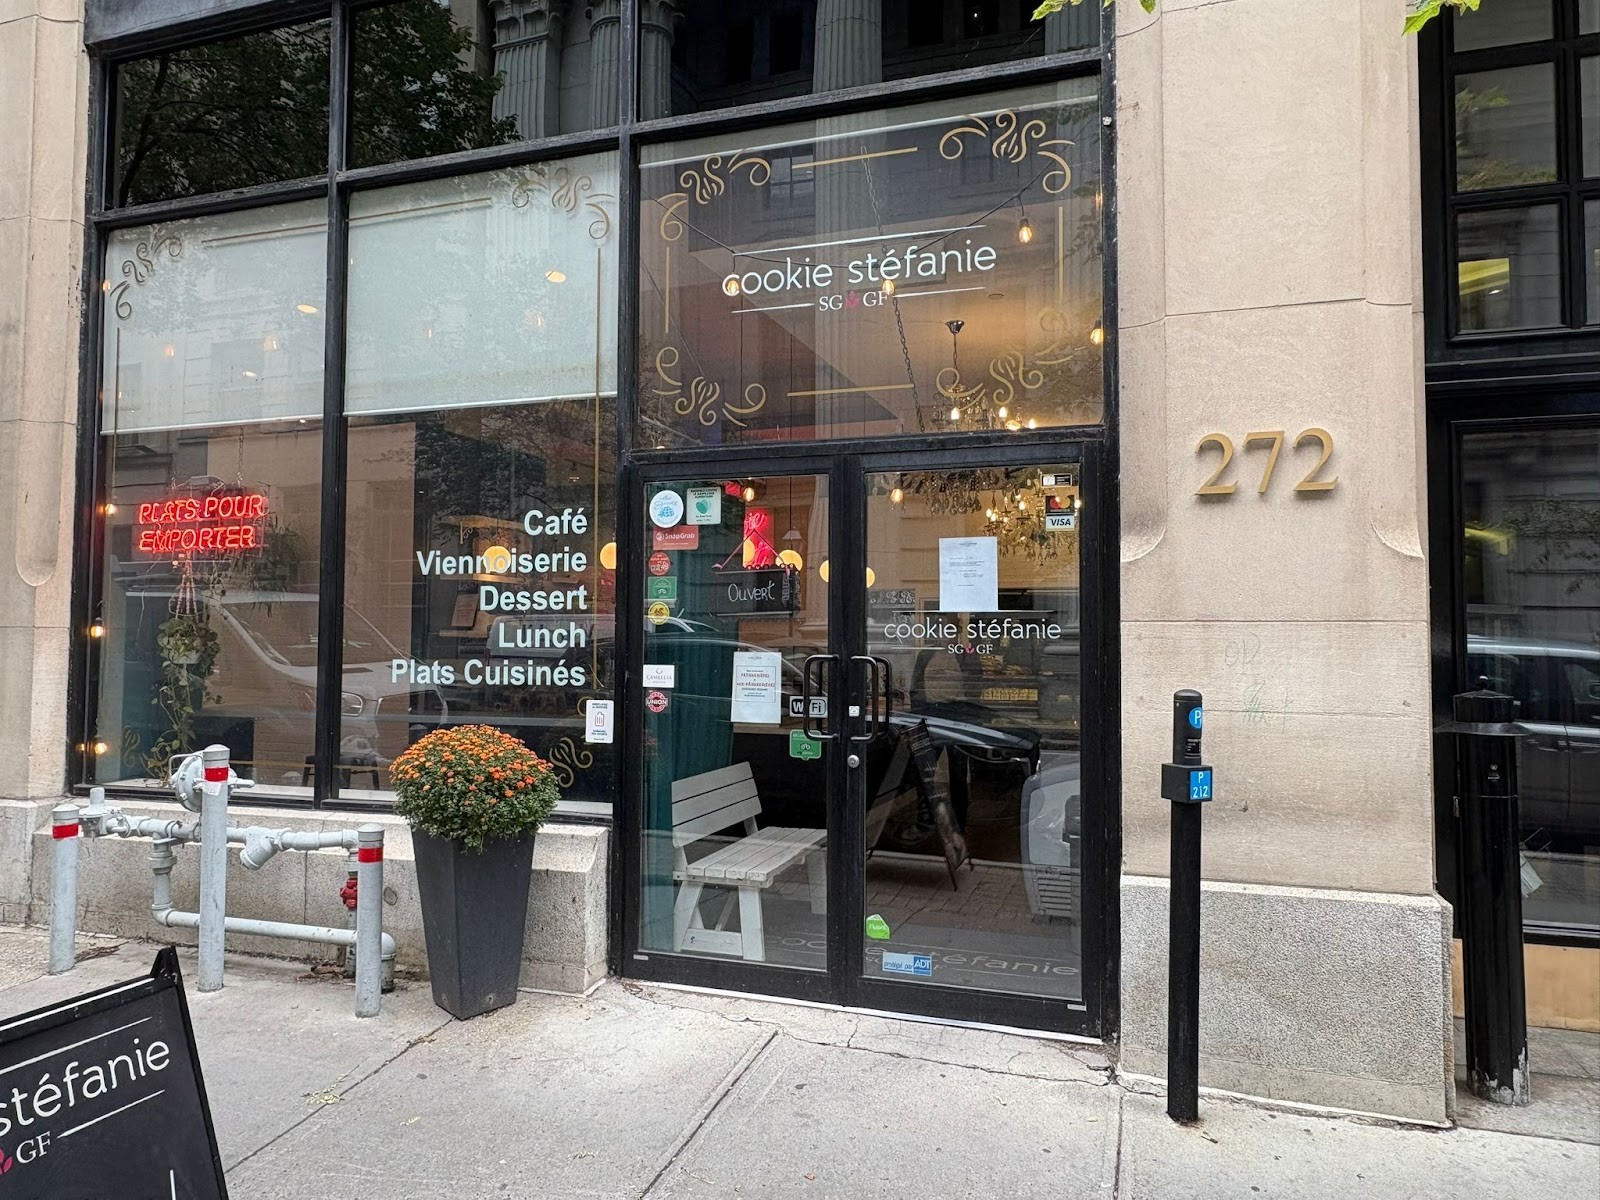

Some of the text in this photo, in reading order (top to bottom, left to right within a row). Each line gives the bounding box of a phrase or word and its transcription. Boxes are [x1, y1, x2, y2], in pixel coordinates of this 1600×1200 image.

[721, 239, 997, 296] cookie stéfanie
[818, 290, 889, 312] SG GF
[1194, 427, 1340, 496] 272
[139, 494, 267, 524] PLATS POUR
[524, 507, 588, 536] Café
[1050, 518, 1071, 526] VISA
[139, 525, 256, 551] EMPORTER
[664, 532, 695, 540] SnapGrab
[416, 546, 588, 576] Viennoiserie
[479, 584, 588, 611] Dessert
[727, 580, 776, 602] Ouvert
[498, 622, 586, 648] Lunch
[884, 616, 1062, 640] cookie stéfanie
[947, 644, 994, 655] SG GF
[391, 658, 586, 686] Plats Cuisinés
[1194, 710, 1202, 725] P
[1198, 771, 1204, 783] P
[1192, 785, 1209, 799] 212
[914, 959, 930, 969] ADT
[16, 1131, 51, 1164] GF
